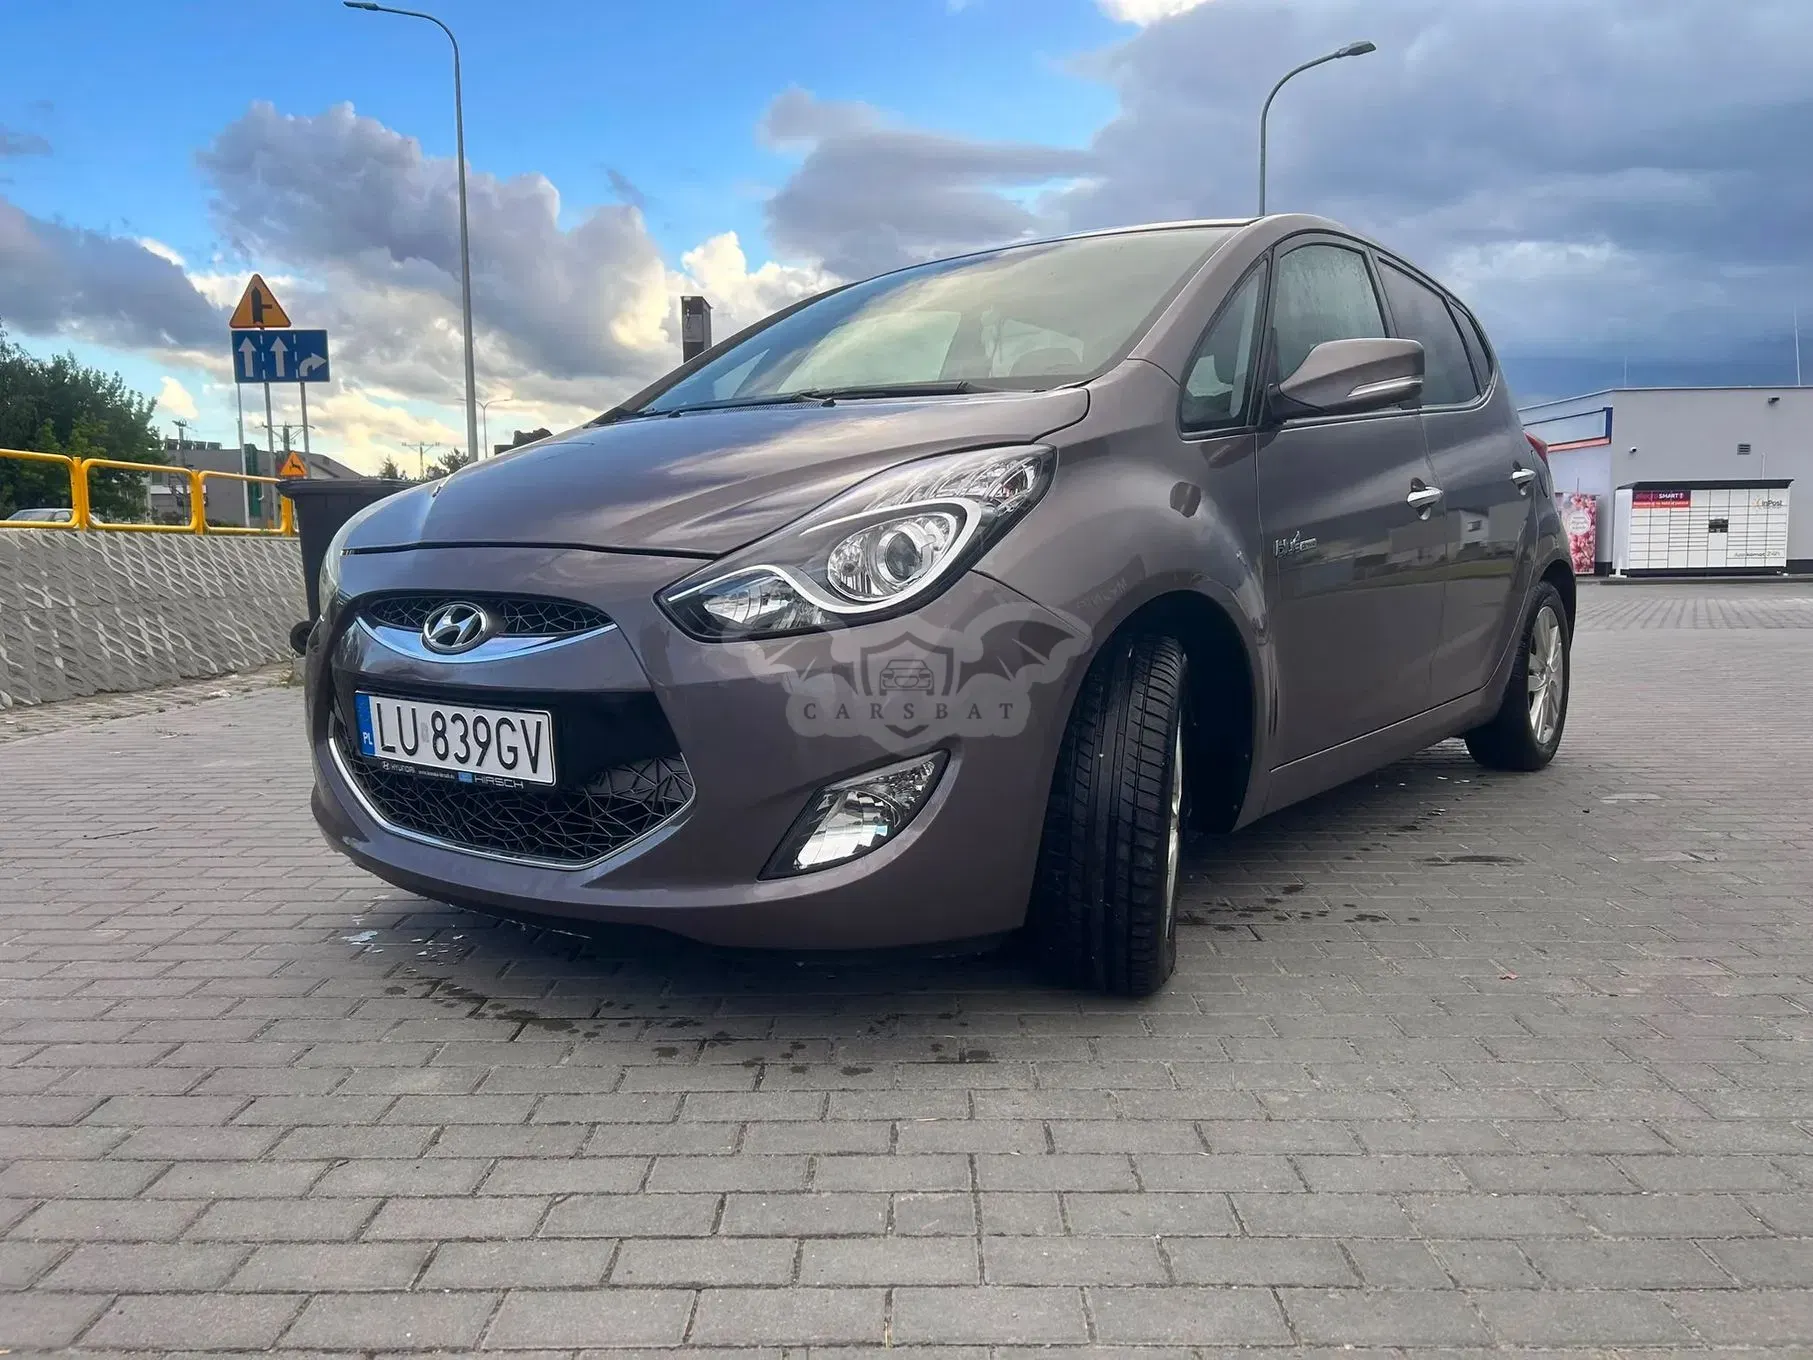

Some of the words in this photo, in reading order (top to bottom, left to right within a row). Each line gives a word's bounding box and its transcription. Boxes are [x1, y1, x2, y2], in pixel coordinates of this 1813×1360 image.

[362, 731, 373, 745] PL
[376, 702, 419, 757] LU
[430, 710, 542, 774] 839GV
[474, 775, 524, 789] HIRSCH
